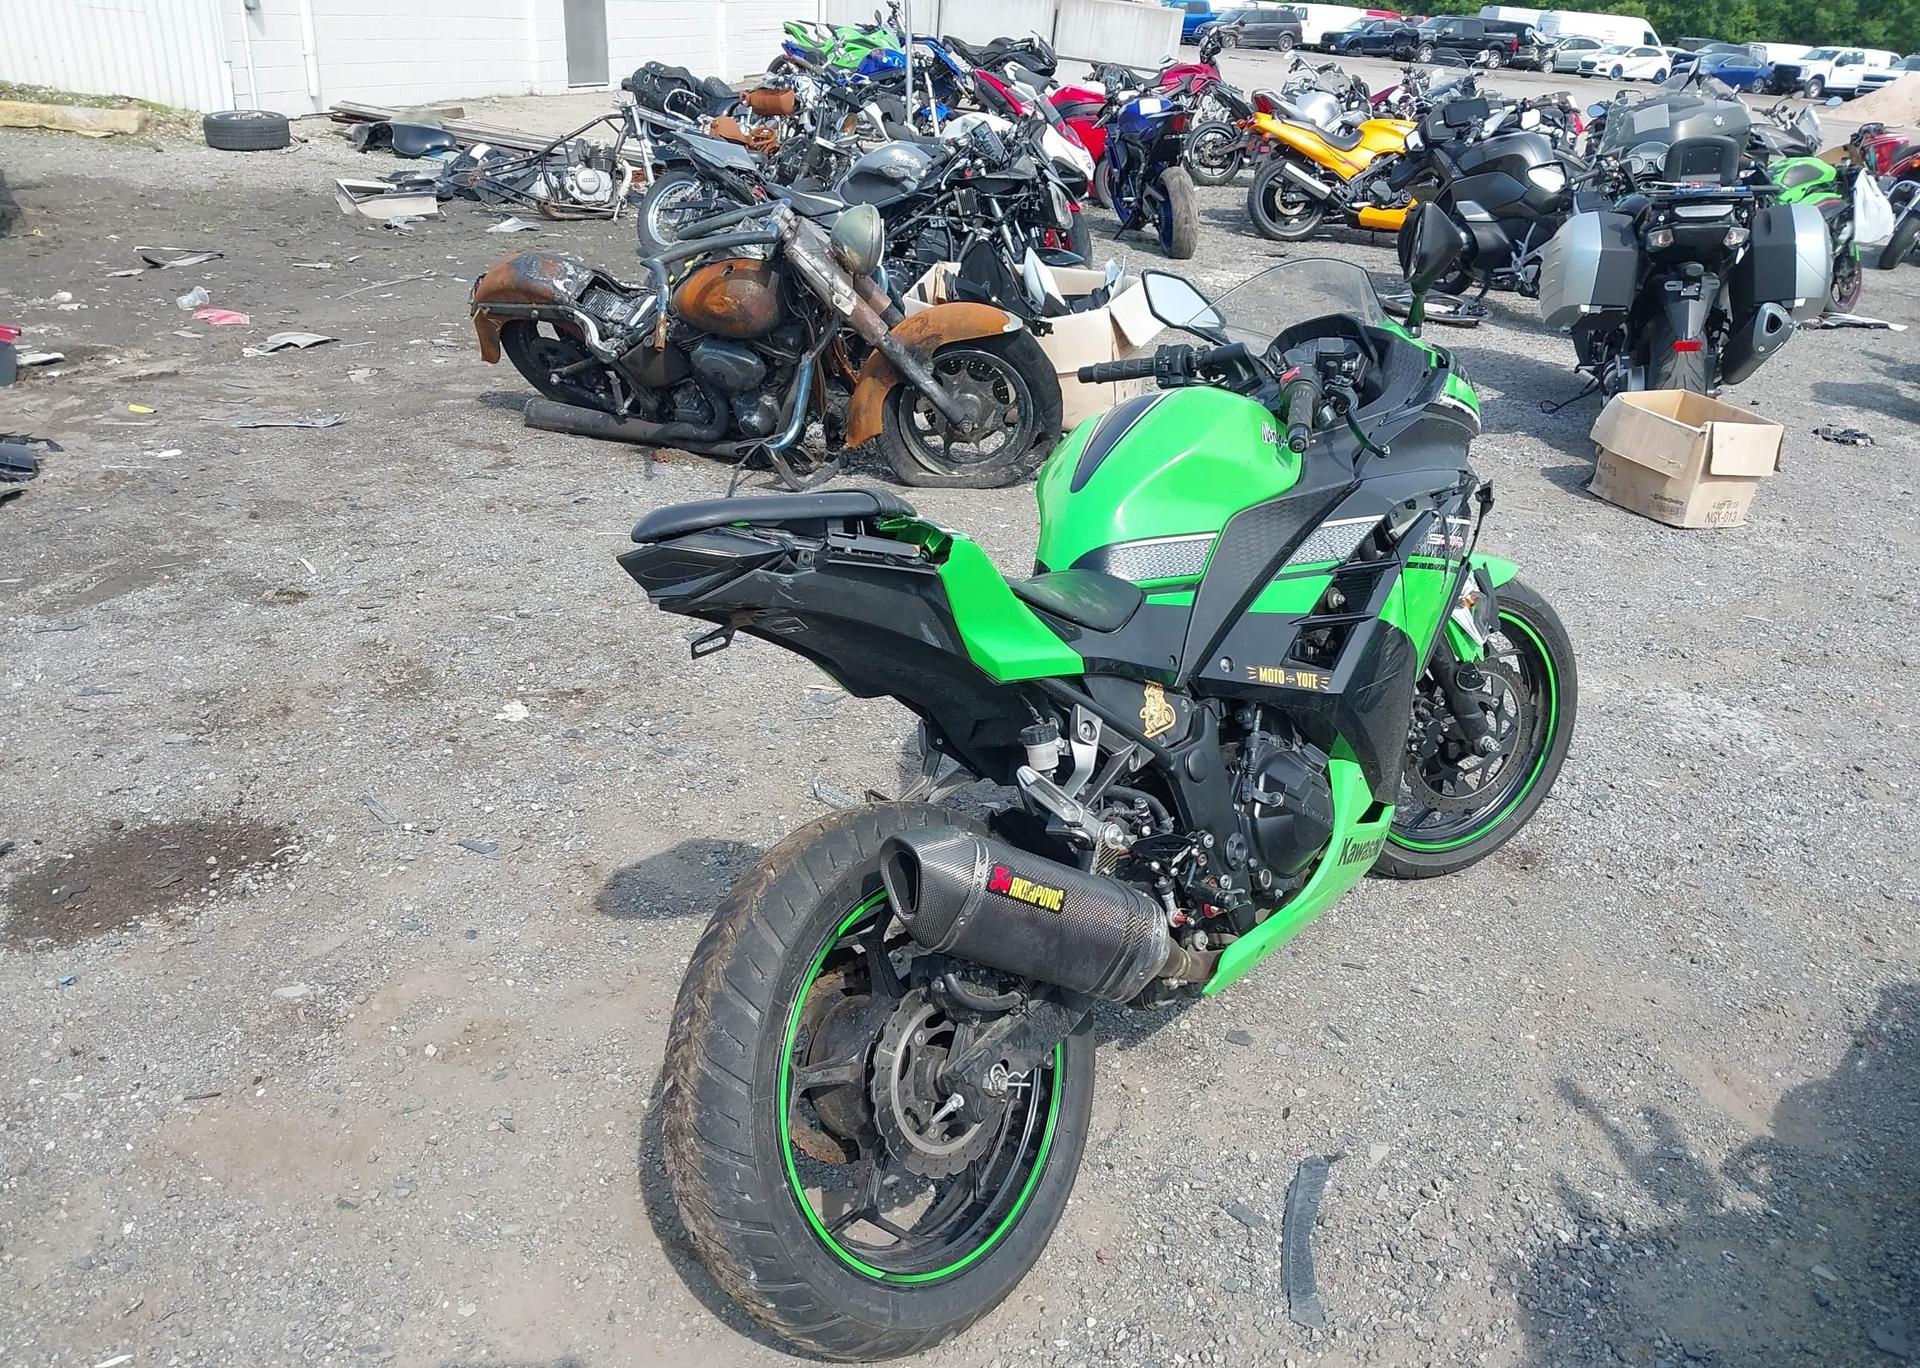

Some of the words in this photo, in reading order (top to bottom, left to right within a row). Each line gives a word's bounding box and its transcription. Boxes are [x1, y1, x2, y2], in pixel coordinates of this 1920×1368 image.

[1259, 667, 1285, 685] MOTO
[1296, 672, 1319, 689] YOTE
[1337, 832, 1385, 867] Kawasak
